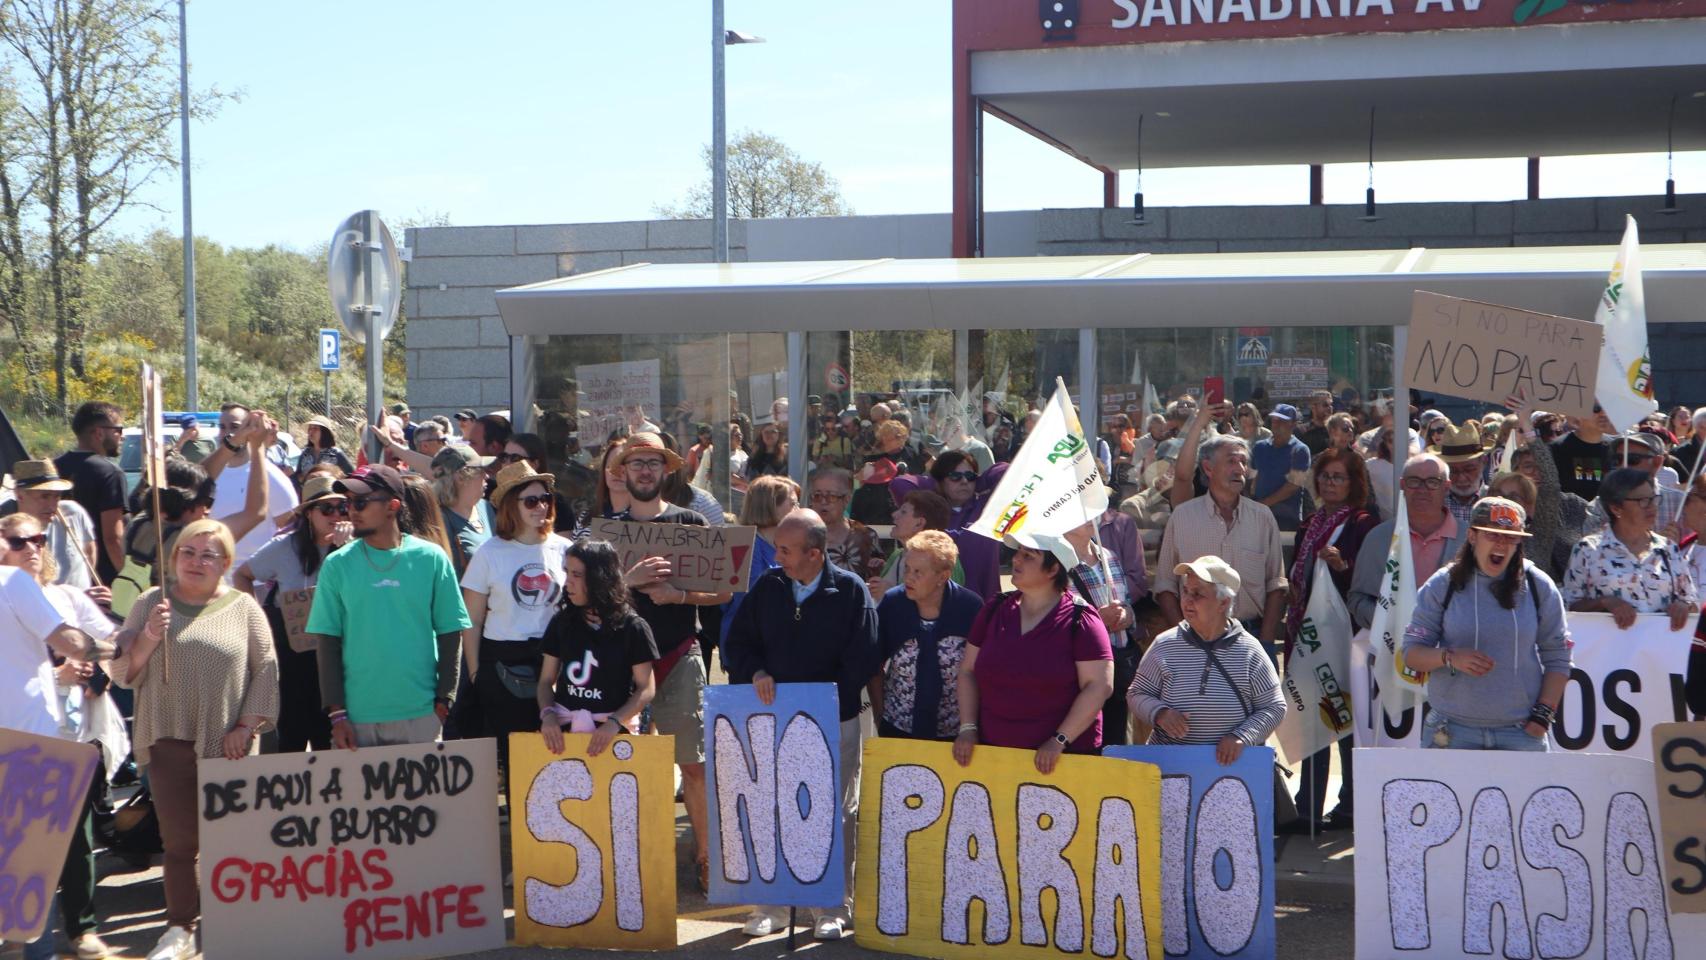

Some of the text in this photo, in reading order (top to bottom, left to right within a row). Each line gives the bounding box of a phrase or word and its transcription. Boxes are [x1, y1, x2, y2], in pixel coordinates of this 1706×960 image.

[322, 334, 336, 365] P
[1478, 309, 1508, 335] NO
[1525, 317, 1585, 348] PARA
[1413, 339, 1479, 388] NO
[1491, 349, 1587, 408] PASA
[600, 521, 726, 549] SANABRIA
[1286, 680, 1305, 712] CAMPO
[203, 779, 247, 820] DE
[320, 767, 343, 803] A
[361, 743, 475, 801] MADRID
[713, 710, 837, 886] NO
[270, 804, 437, 847] EN BURRO
[210, 846, 395, 903] GRACIAS
[876, 763, 1150, 960] PARA
[1382, 778, 1675, 960] PASA
[343, 884, 488, 954] RENFE
